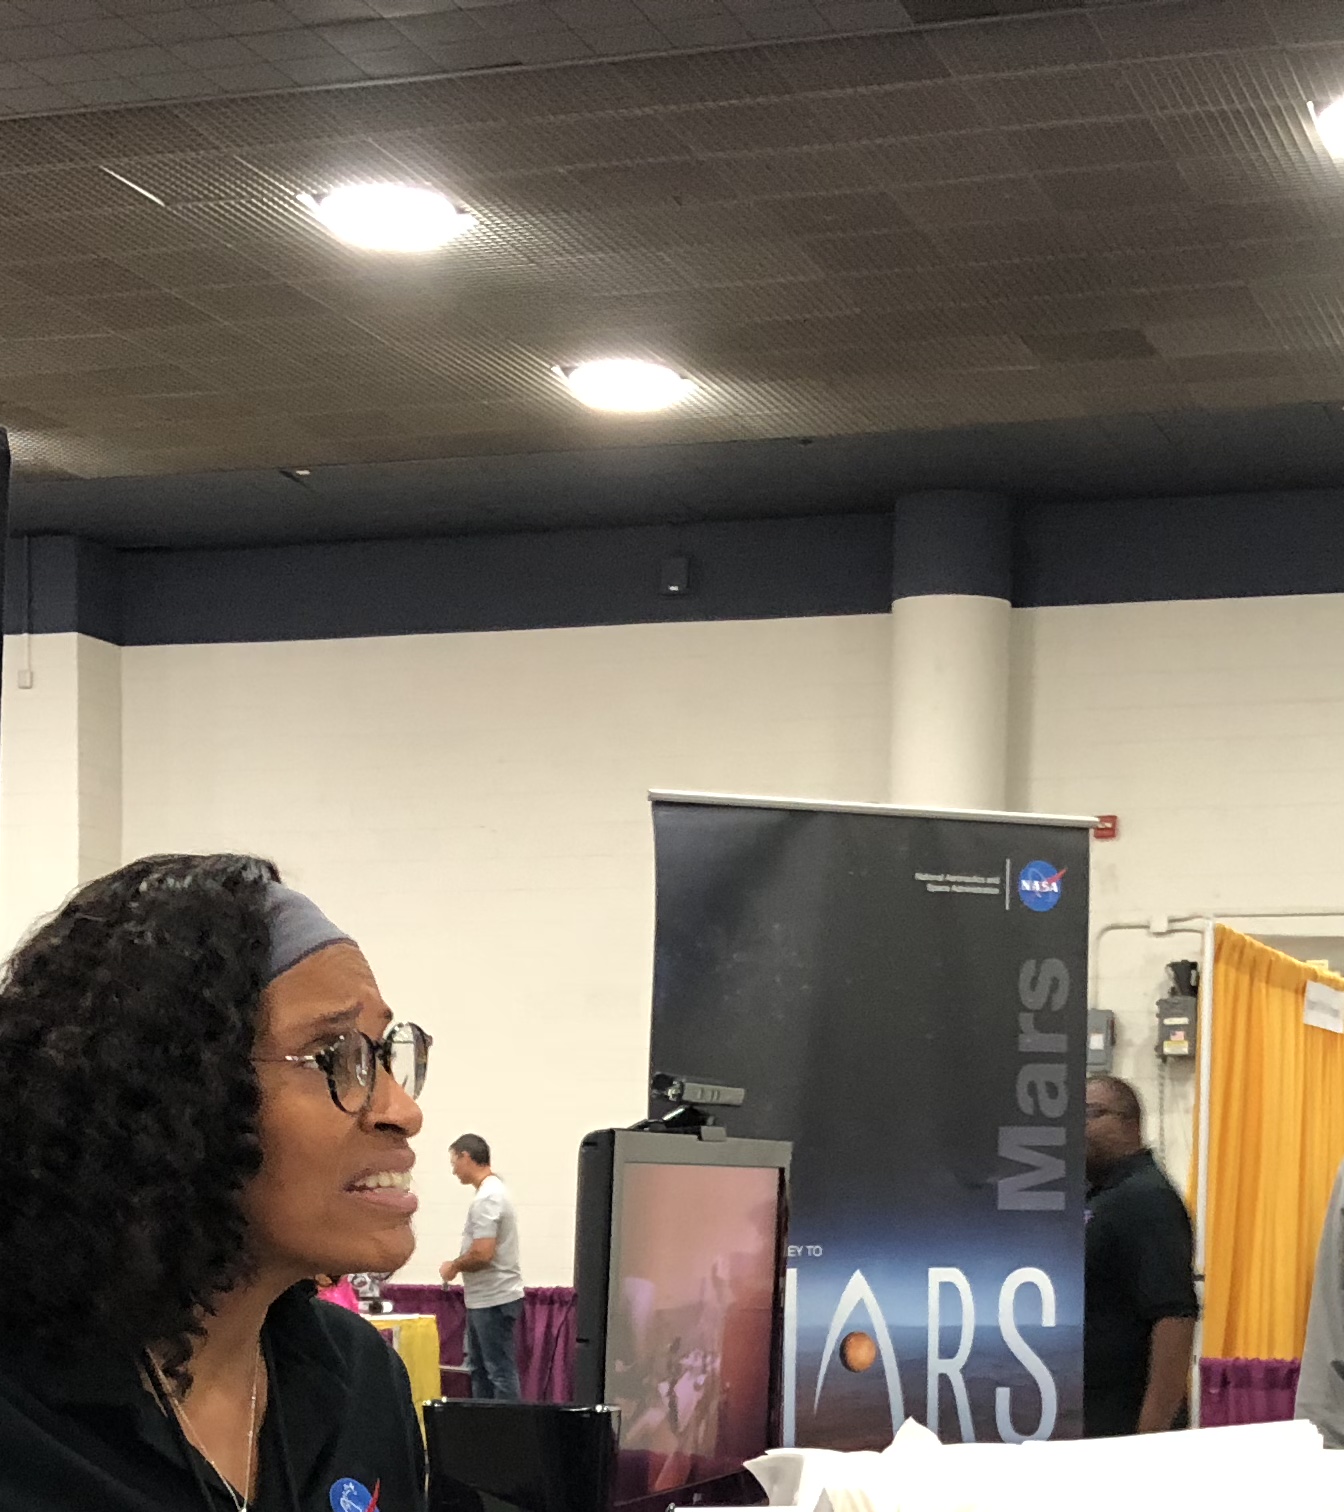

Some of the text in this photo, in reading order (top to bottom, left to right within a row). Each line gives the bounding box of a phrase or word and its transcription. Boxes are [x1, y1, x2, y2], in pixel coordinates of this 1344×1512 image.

[1021, 880, 1058, 893] NASA
[997, 957, 1069, 1211] Mars
[788, 1245, 823, 1256] EY TO
